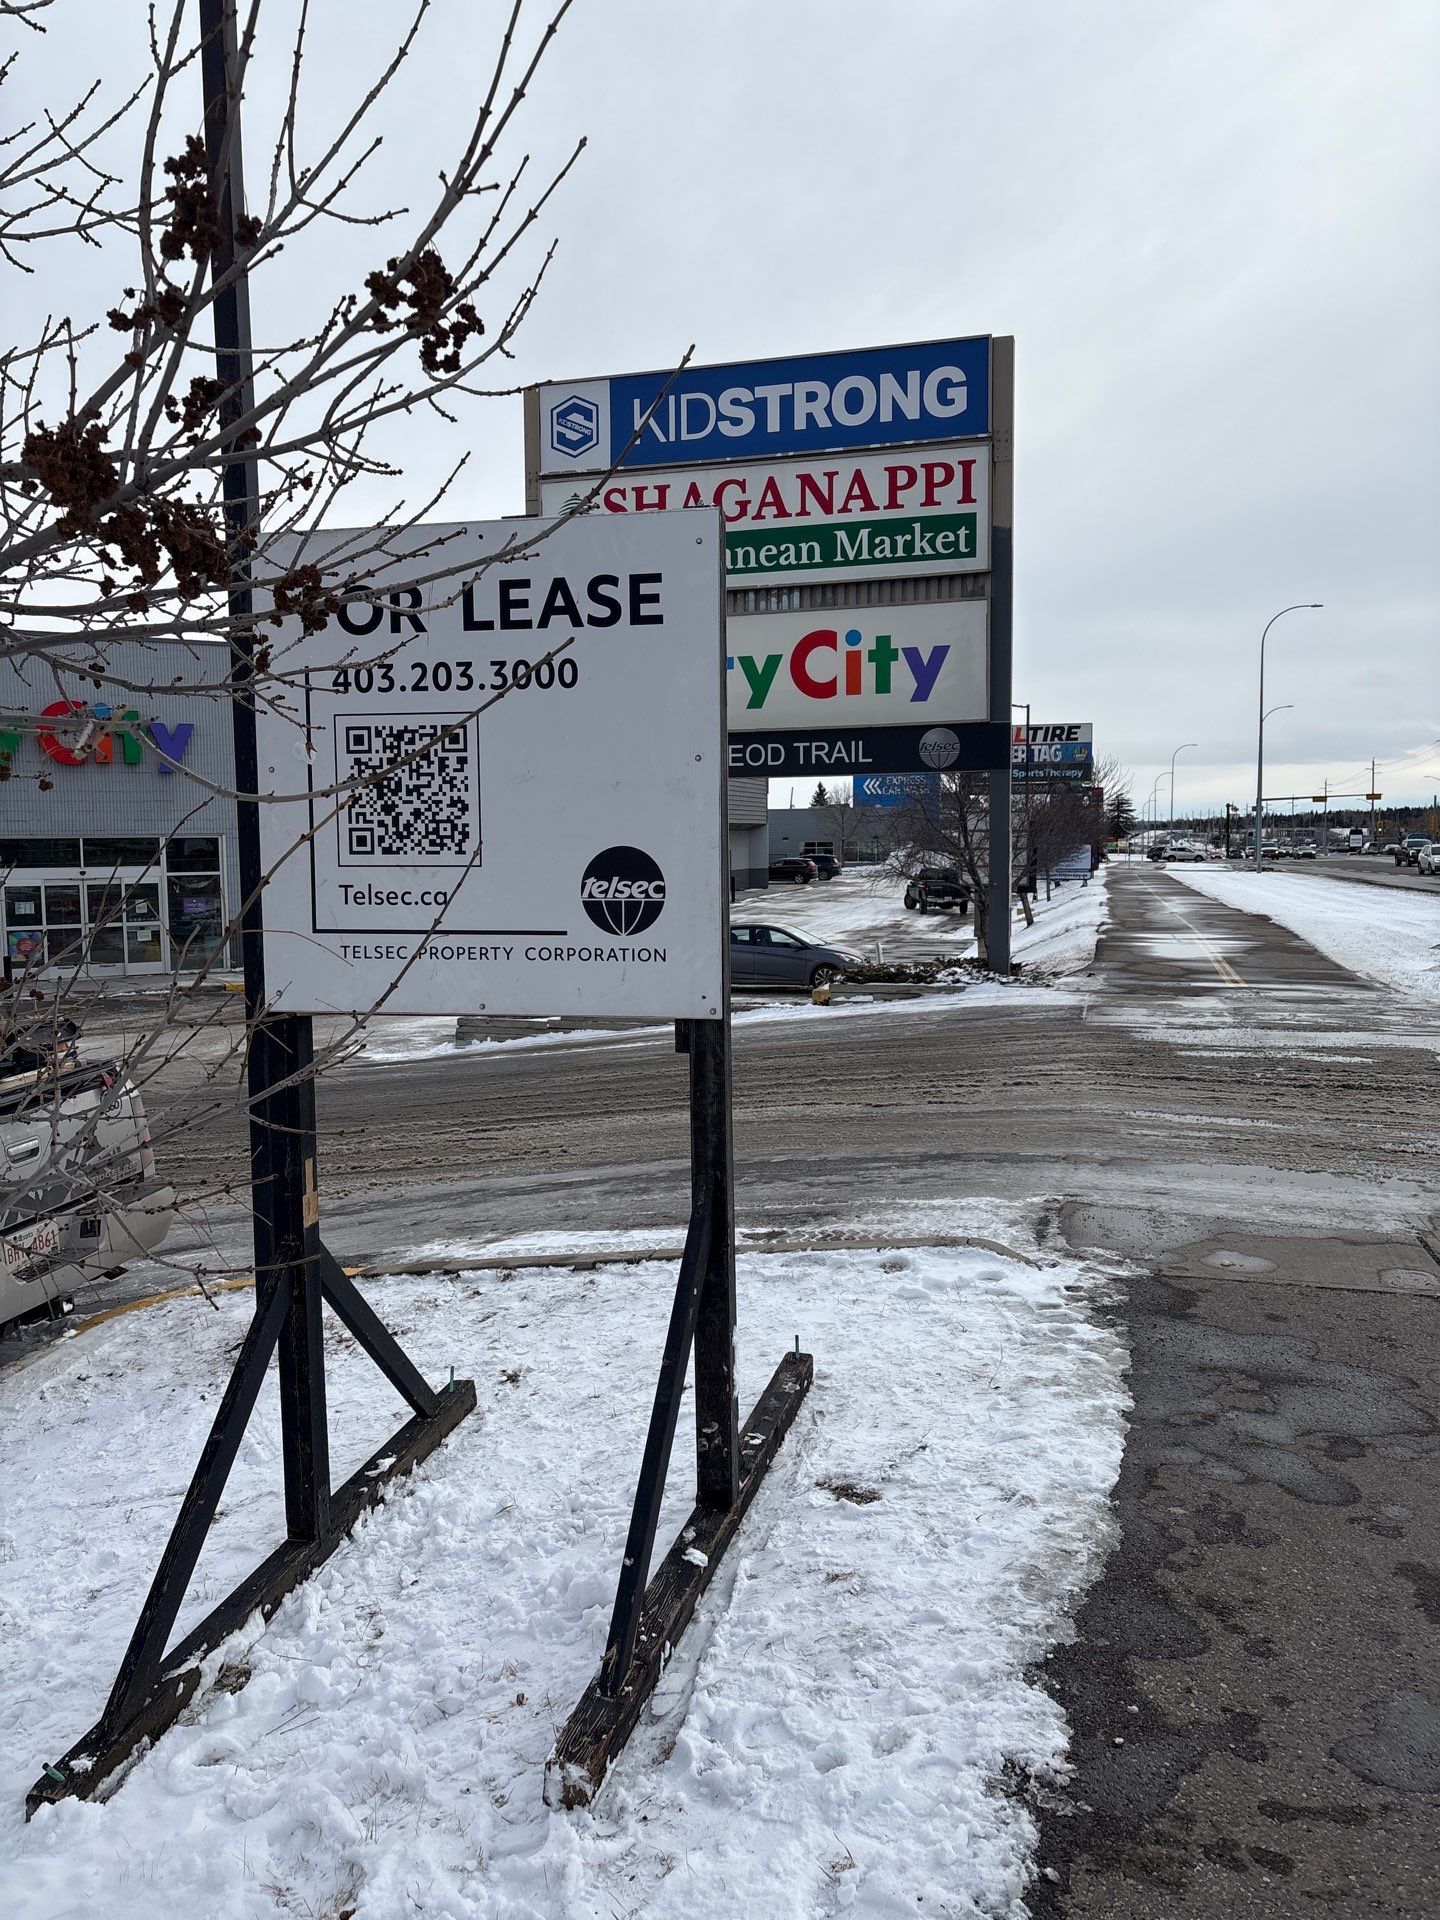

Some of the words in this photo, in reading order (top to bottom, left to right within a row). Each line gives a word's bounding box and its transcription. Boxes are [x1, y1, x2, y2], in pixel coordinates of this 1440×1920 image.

[632, 365, 969, 446] KIDSTRONG
[603, 458, 978, 523] SHAGANAPPI
[833, 521, 972, 562] Market
[303, 583, 428, 637] OR
[461, 572, 665, 633] LEASE
[332, 657, 579, 694] 403.203.3000
[793, 740, 873, 765] TRAIL
[920, 741, 960, 752] telsec
[1031, 744, 1062, 762] TAG
[338, 883, 449, 907] Telsec.ca
[580, 874, 666, 900] telsec
[340, 944, 408, 961] TELSEC
[417, 946, 515, 963] PROPERTY
[524, 946, 668, 964] CORPORATION
